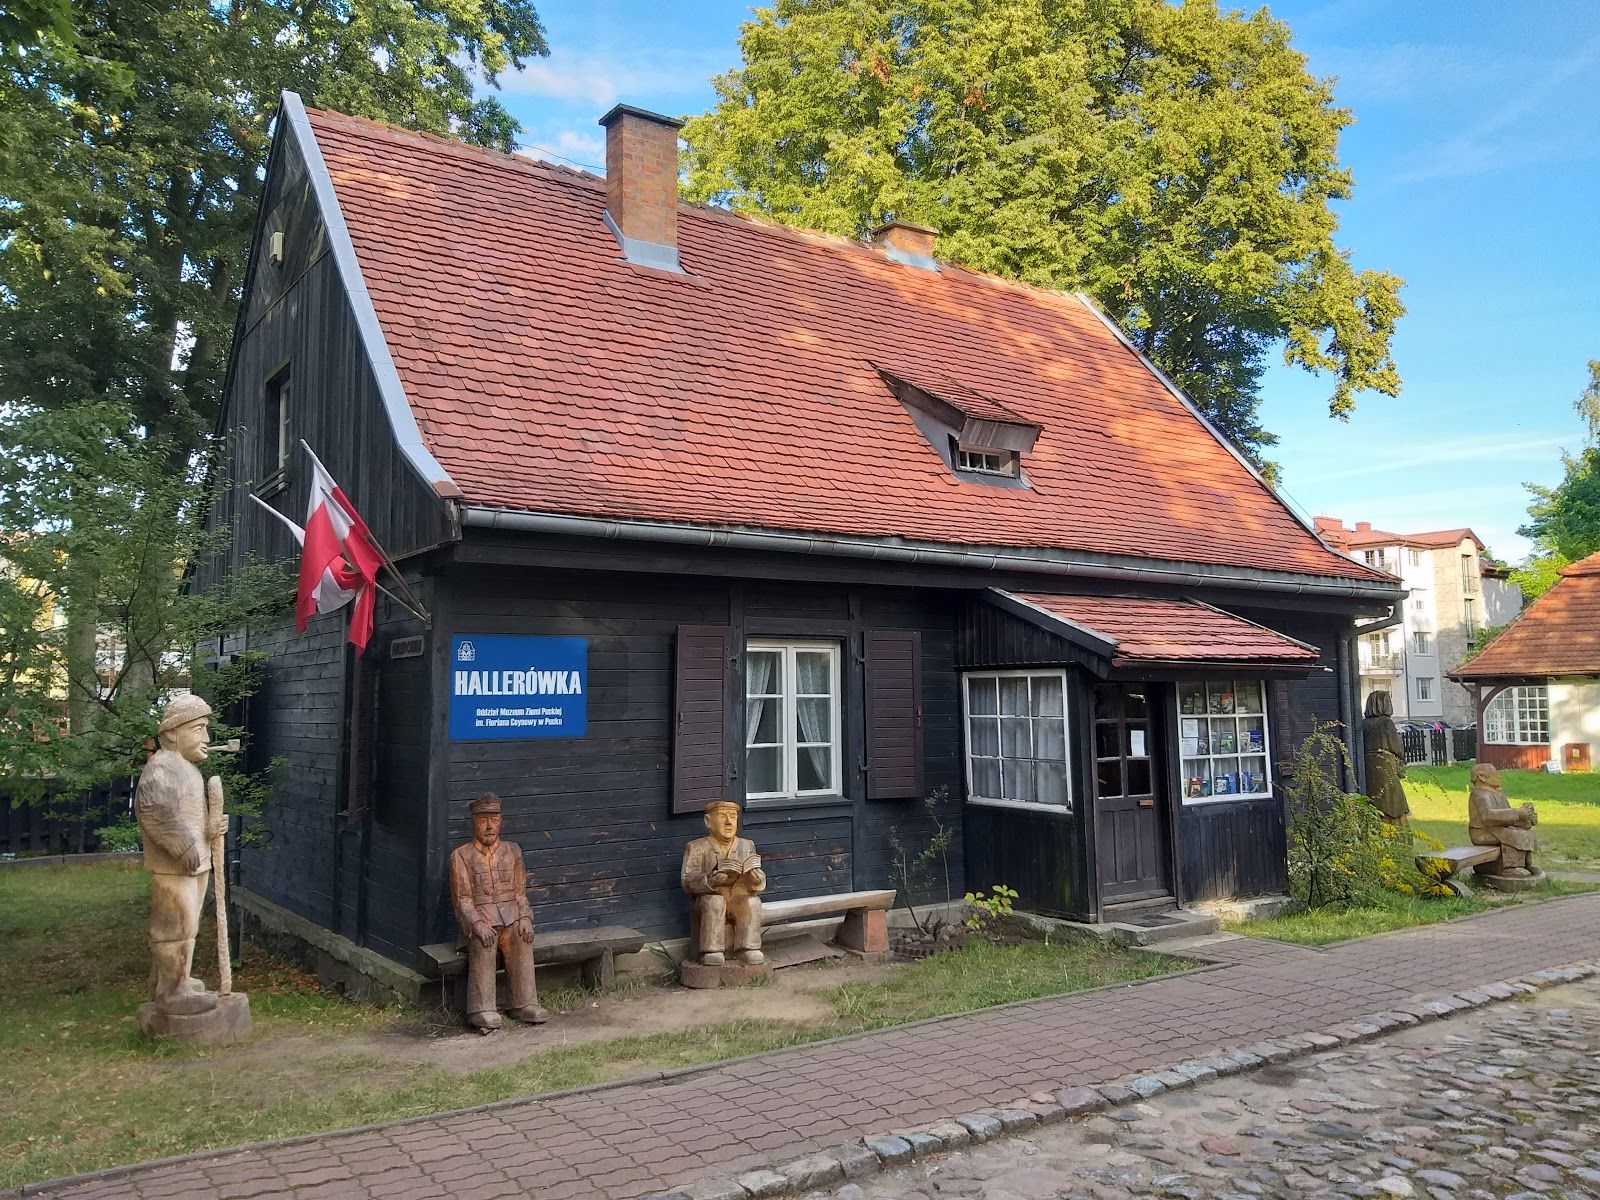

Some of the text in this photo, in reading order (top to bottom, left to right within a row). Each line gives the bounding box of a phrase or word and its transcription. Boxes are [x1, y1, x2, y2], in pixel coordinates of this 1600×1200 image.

[455, 667, 582, 696] HALLERÓWKA
[476, 706, 563, 717] Oddział Muzeum Ziemi Puckiej
[475, 719, 485, 727] im.
[486, 718, 510, 727] Floriana
[510, 717, 537, 727] Ceynowy
[544, 717, 563, 726] Pucku
